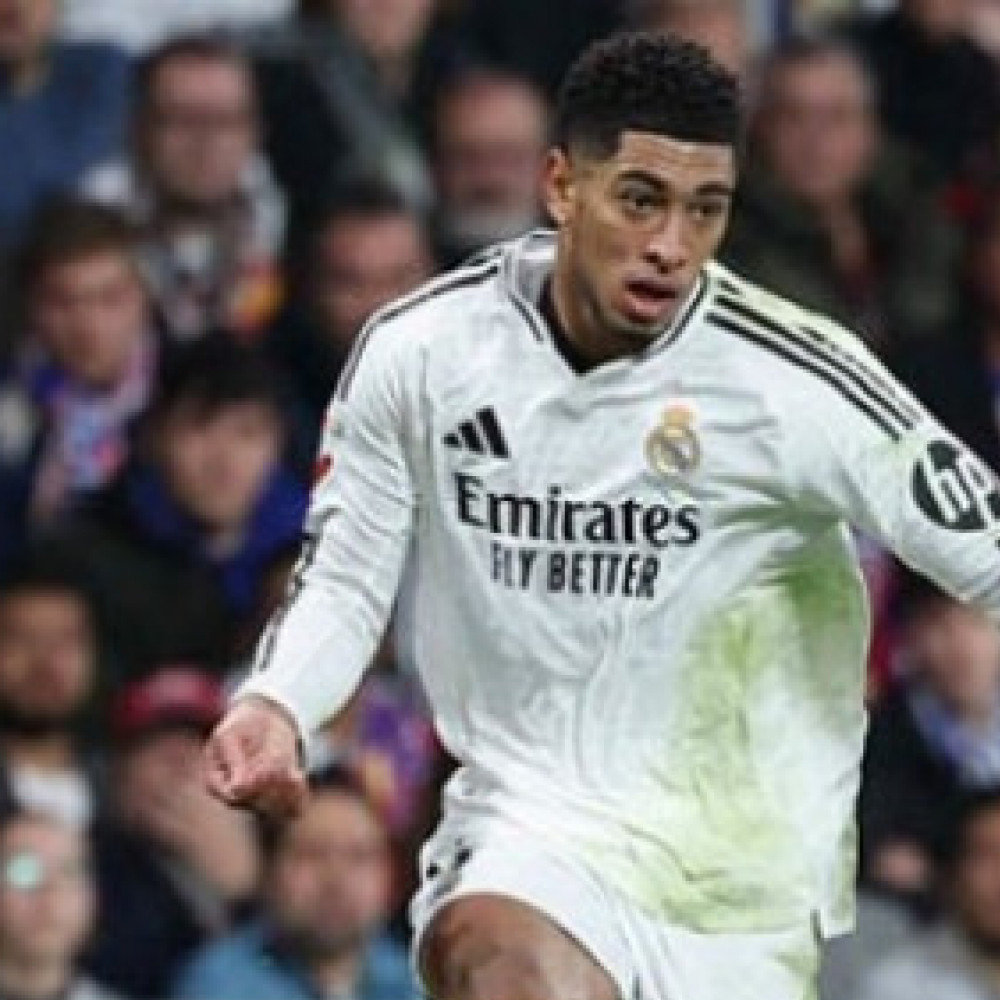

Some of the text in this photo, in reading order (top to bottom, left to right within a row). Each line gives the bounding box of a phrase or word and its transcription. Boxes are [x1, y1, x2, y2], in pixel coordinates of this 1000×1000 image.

[455, 472, 699, 547] Emirates
[490, 541, 661, 599] FLY BETTER
